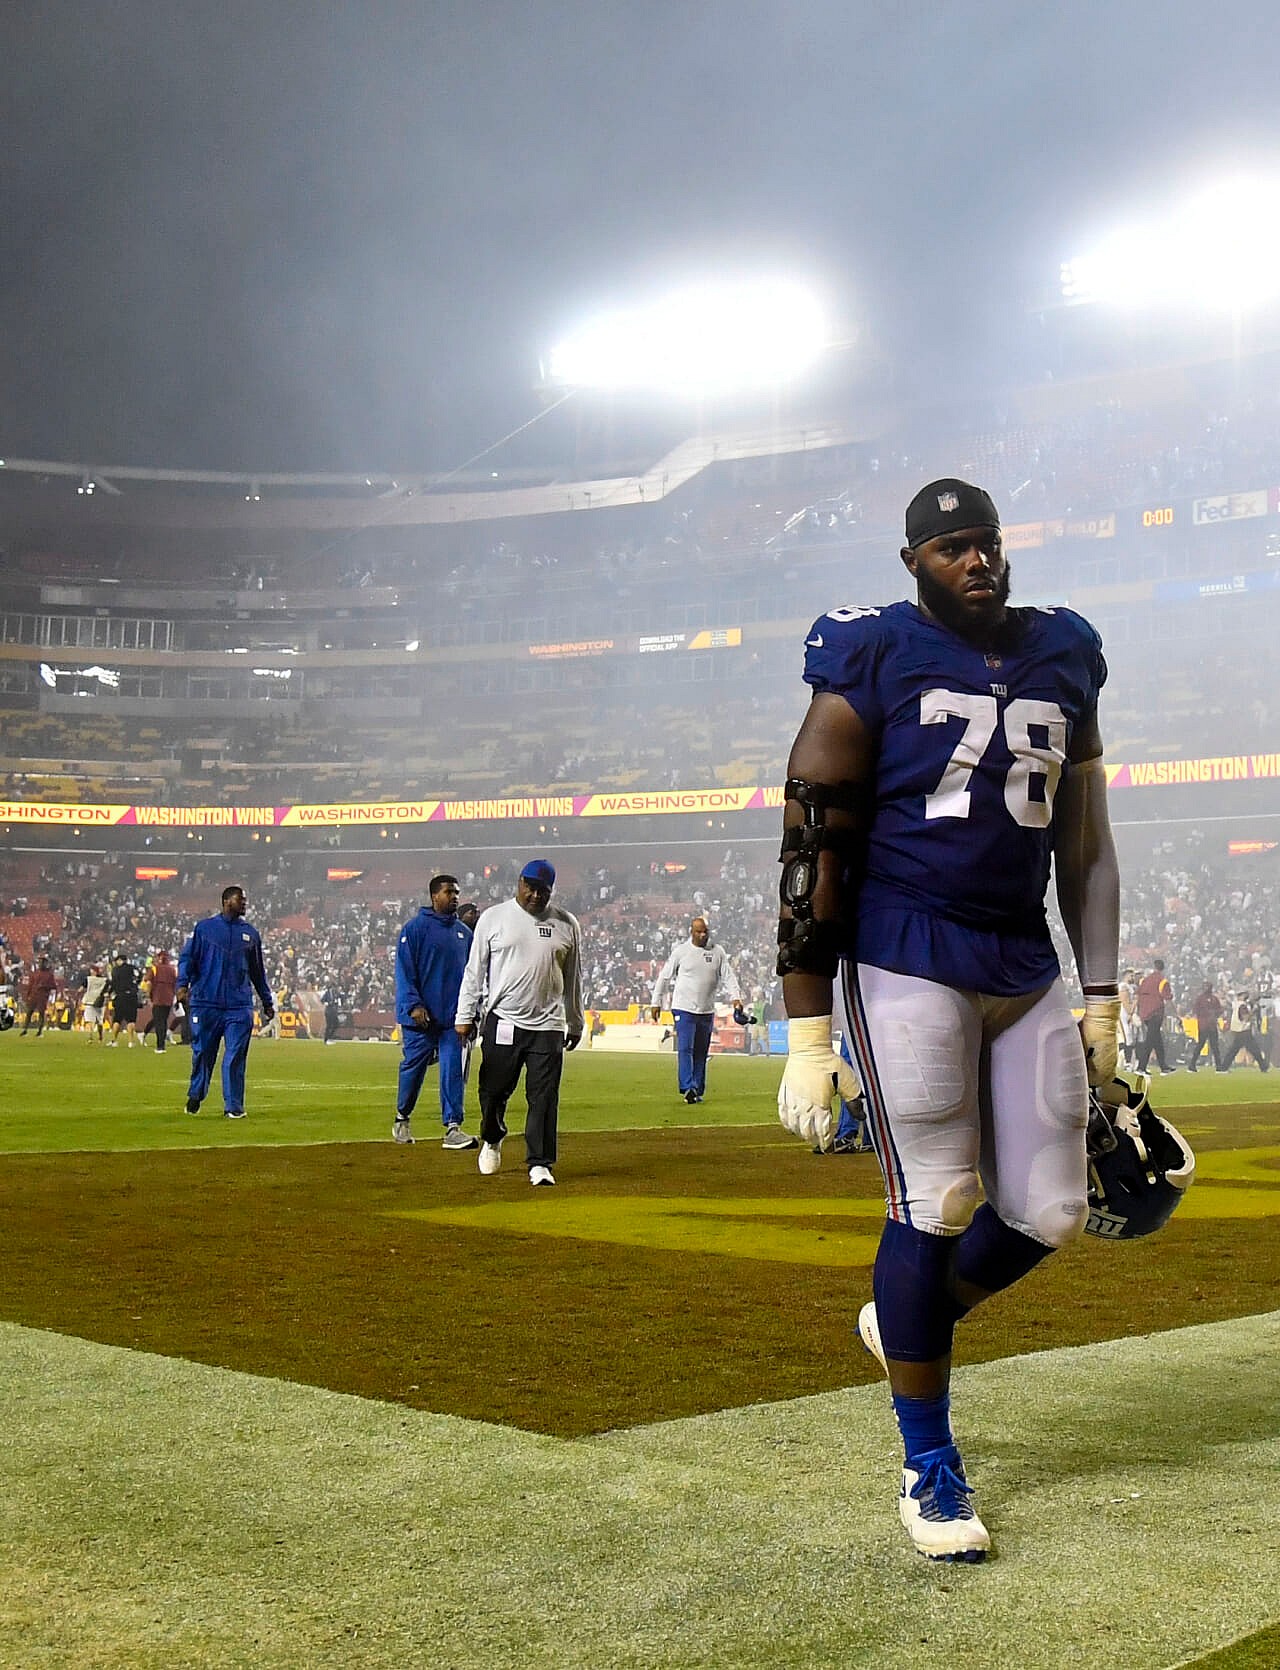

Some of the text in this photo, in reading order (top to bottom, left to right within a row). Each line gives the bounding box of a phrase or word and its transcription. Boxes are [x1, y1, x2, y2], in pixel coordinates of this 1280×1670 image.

[1143, 508, 1173, 527] 0:00
[1196, 495, 1257, 521] FedEx
[528, 640, 614, 655] WASHINGTON
[920, 689, 1067, 828] 78
[1129, 756, 1249, 785] WASHINGTON
[444, 797, 573, 820] WASHINGTON WINS
[600, 793, 739, 811] WASHINGTON
[136, 807, 274, 825] WASHINGTON WINS
[299, 806, 423, 821] WASHINGTON
